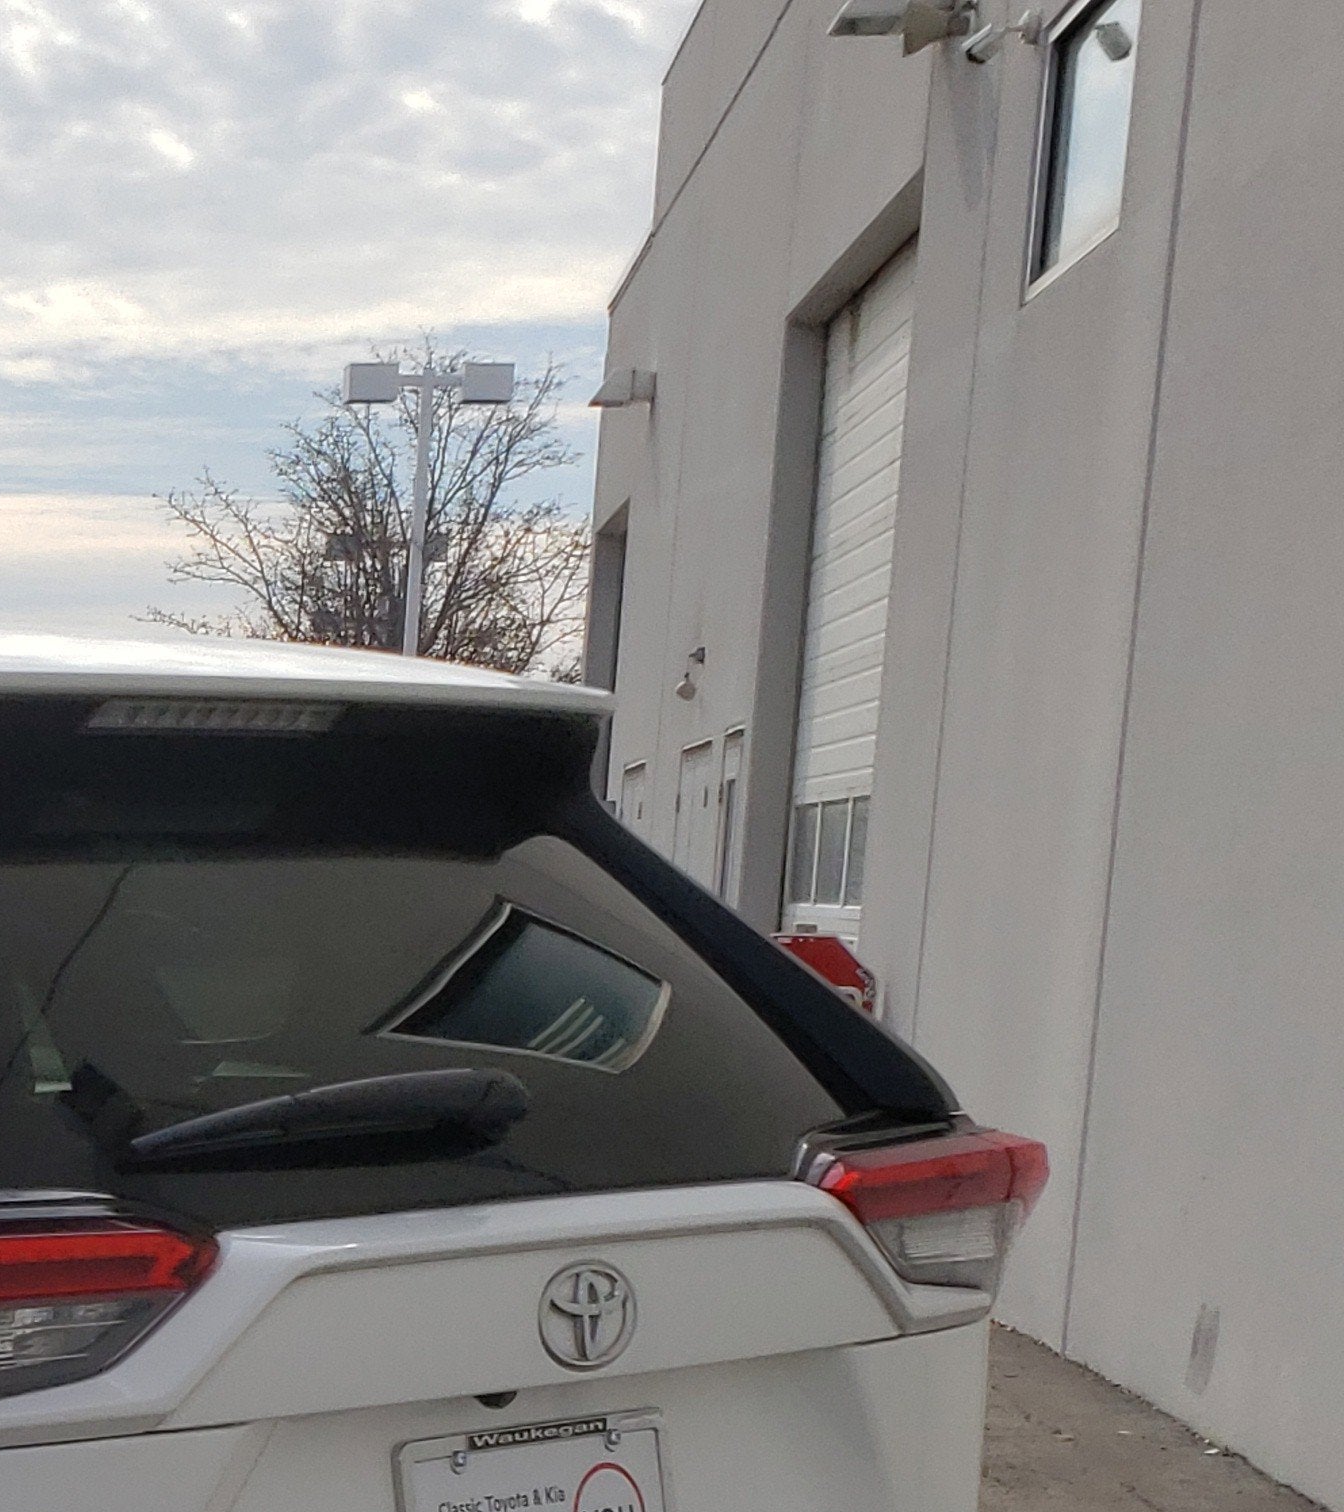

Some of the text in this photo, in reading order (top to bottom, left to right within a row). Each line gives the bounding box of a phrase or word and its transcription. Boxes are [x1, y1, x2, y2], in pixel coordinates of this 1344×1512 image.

[473, 1421, 605, 1447] Waukegan
[484, 1493, 529, 1512] Toyota
[533, 1489, 543, 1506] &
[544, 1486, 566, 1504] Kia
